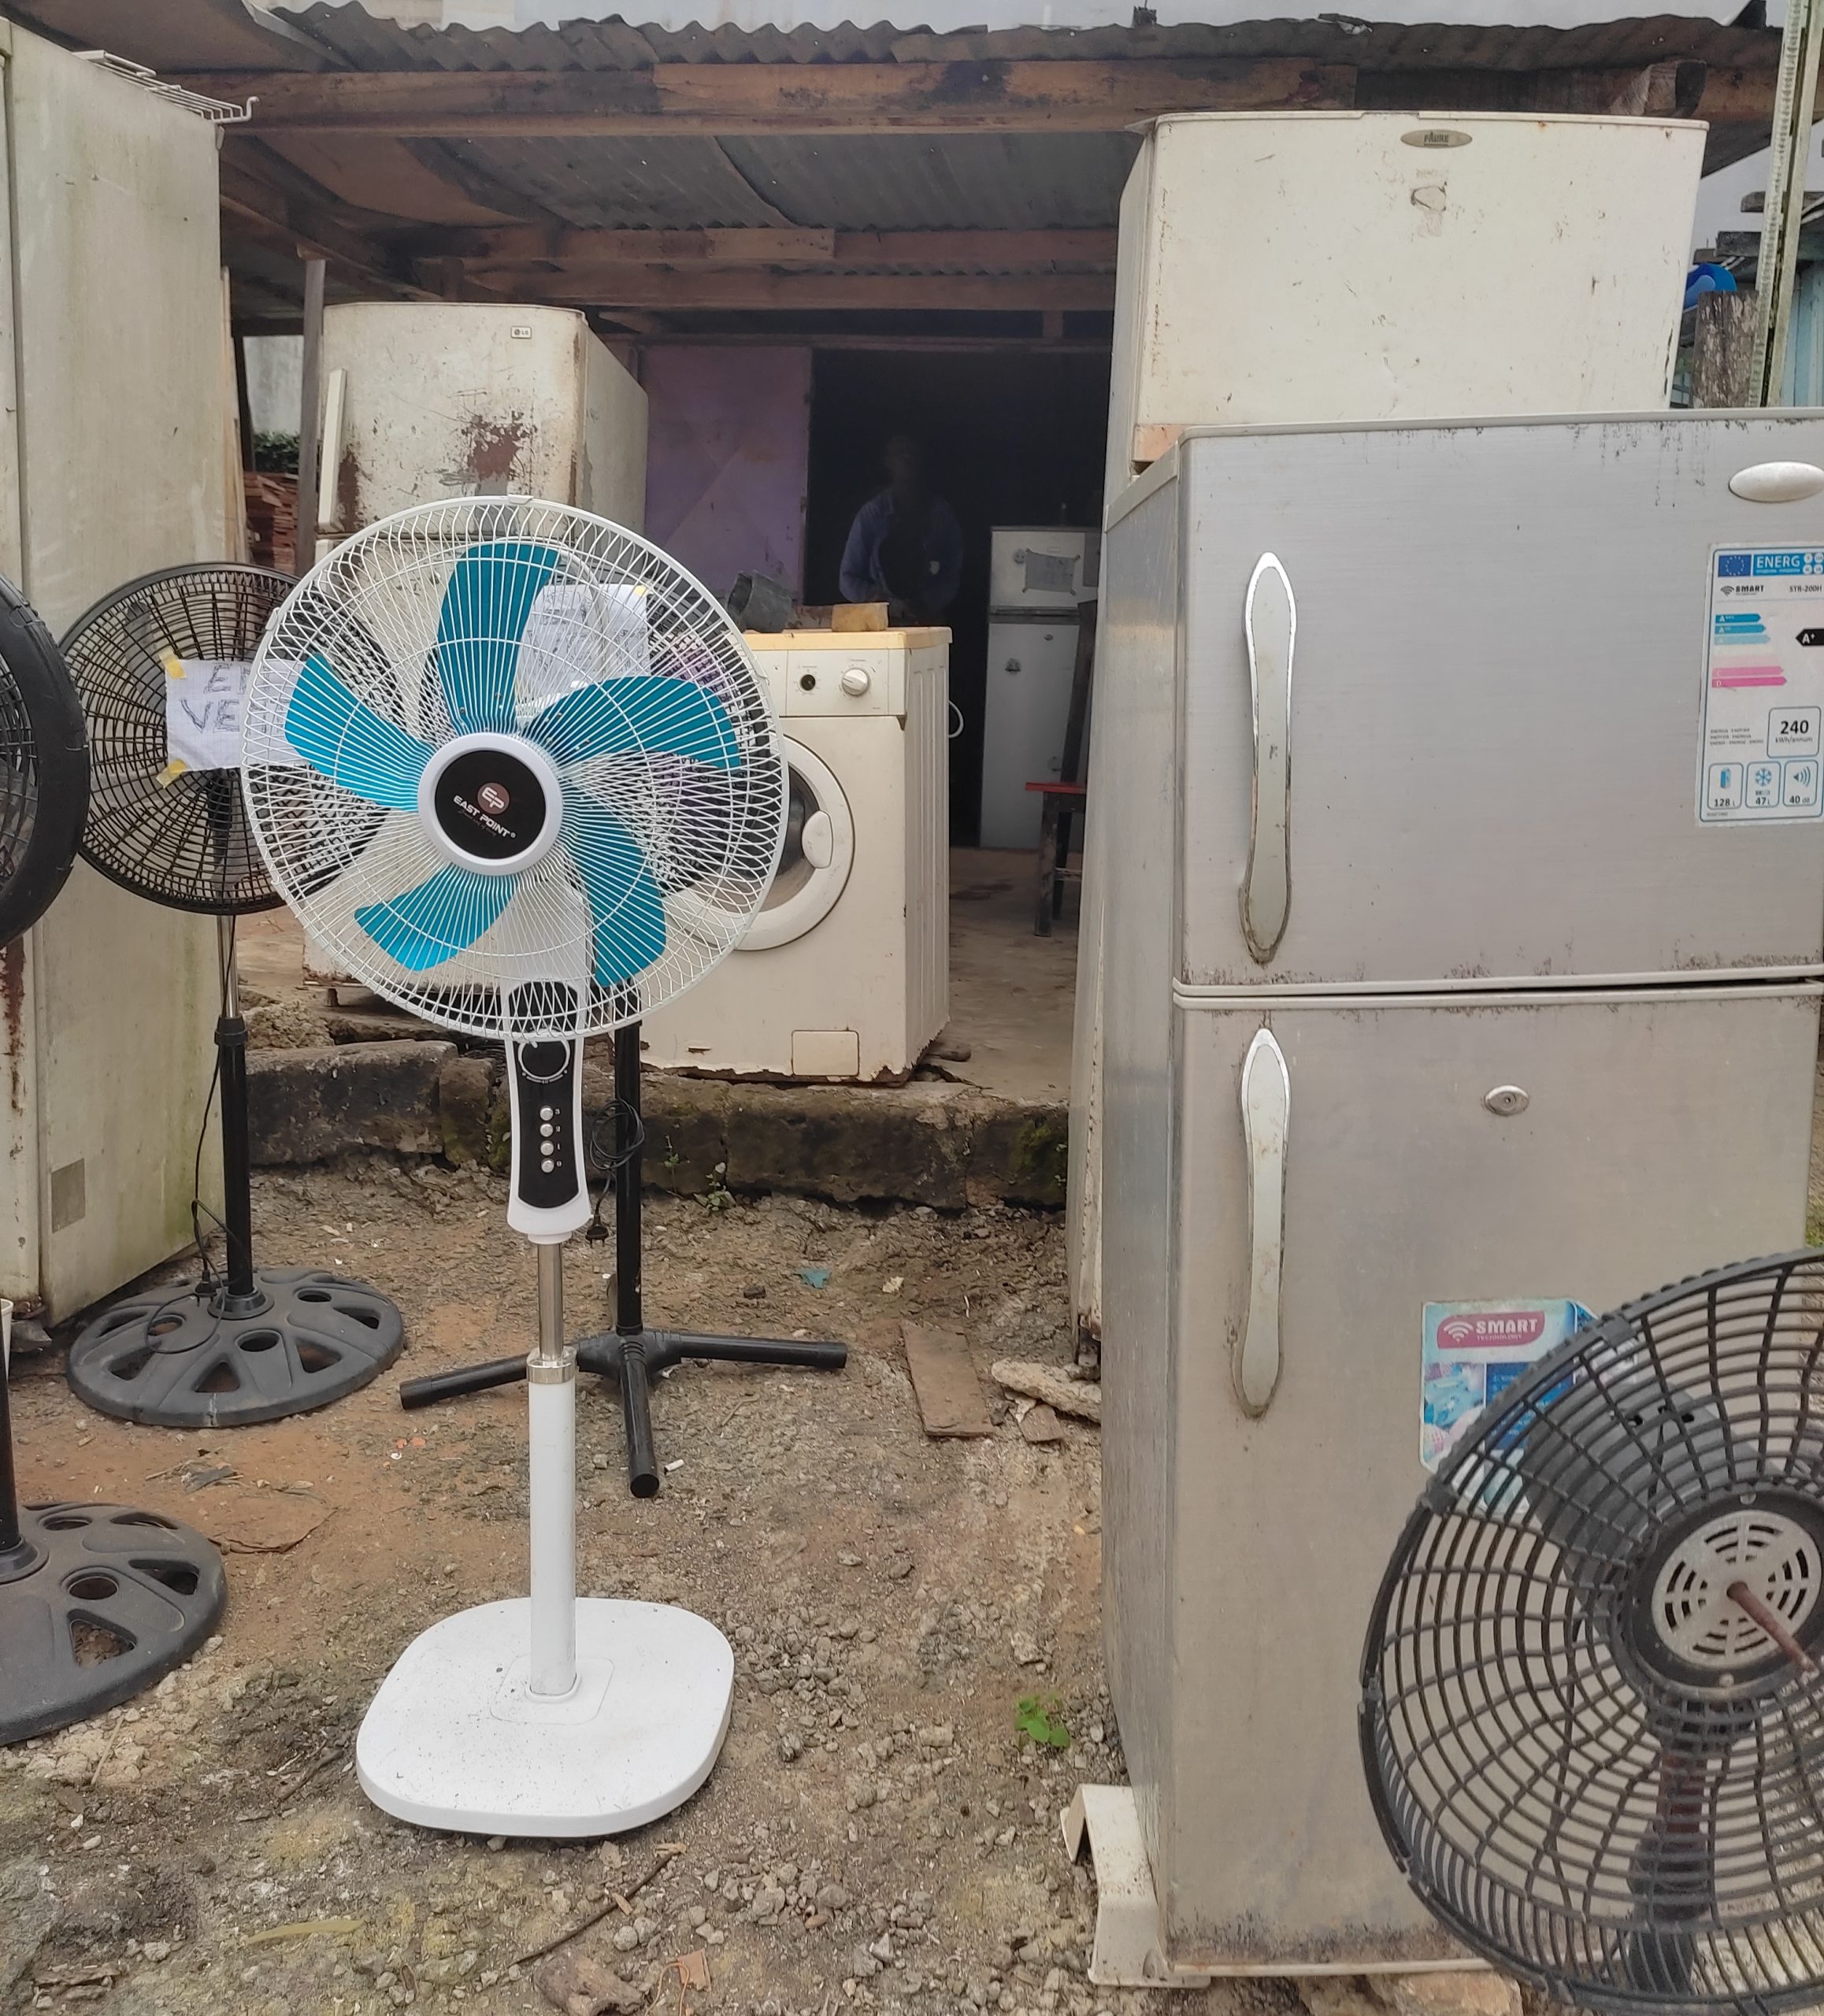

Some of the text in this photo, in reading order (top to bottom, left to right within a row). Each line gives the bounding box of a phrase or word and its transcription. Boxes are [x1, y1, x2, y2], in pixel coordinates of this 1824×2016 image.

[1756, 555, 1800, 569] ENERG
[1780, 720, 1809, 735] 240
[1714, 798, 1730, 807] 128
[1755, 796, 1767, 806] 47
[1789, 795, 1800, 804] 40
[453, 795, 480, 816] EAST
[479, 813, 511, 838] POINT
[1475, 1318, 1538, 1335] SMART
